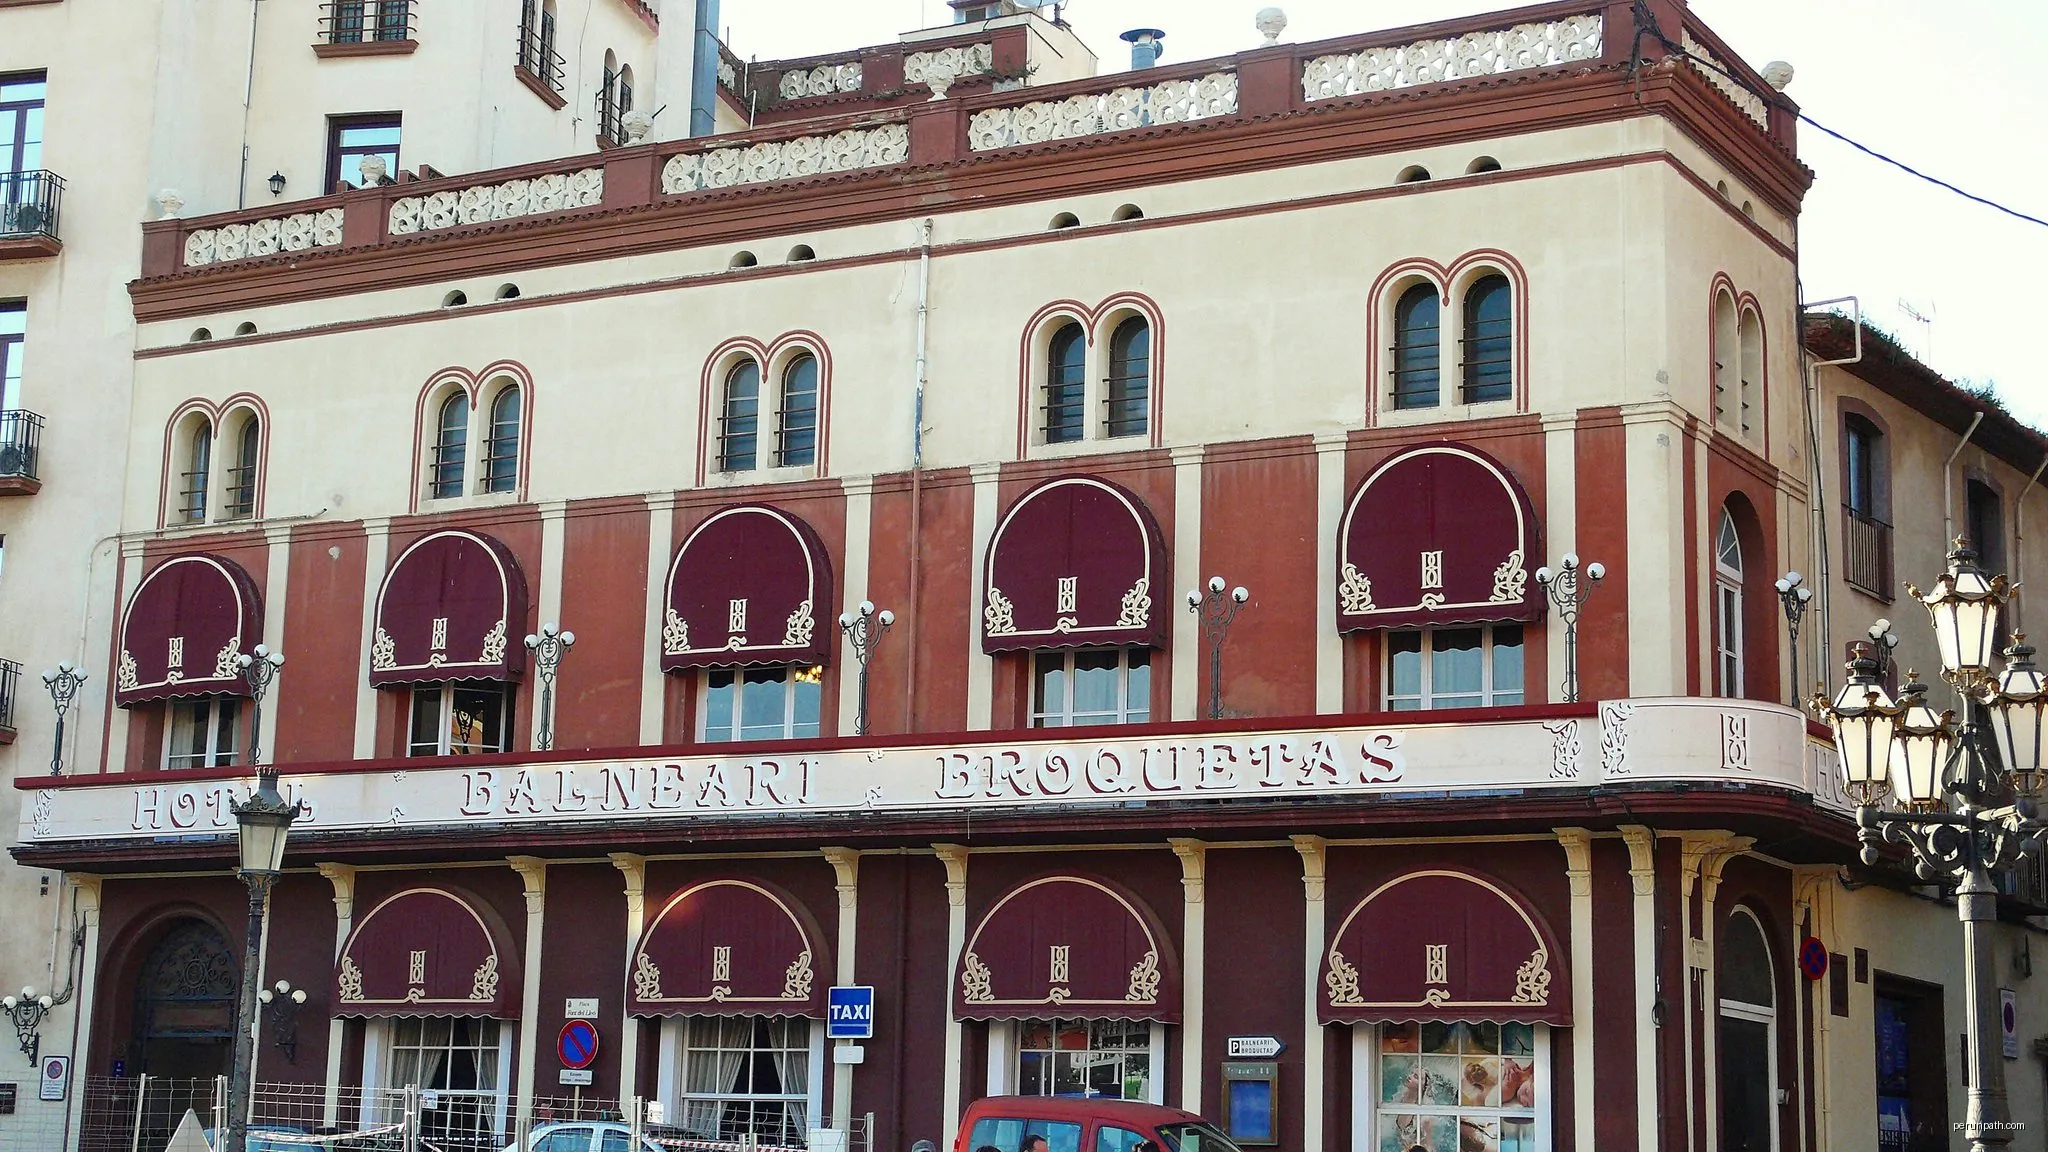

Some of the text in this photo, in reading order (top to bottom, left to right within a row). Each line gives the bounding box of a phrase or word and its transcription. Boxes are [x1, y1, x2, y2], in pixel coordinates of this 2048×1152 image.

[132, 730, 1408, 830] HOTL BALNEARI BROQUETAS
[831, 1005, 869, 1020] TAXI
[1232, 1042, 1239, 1052] P
